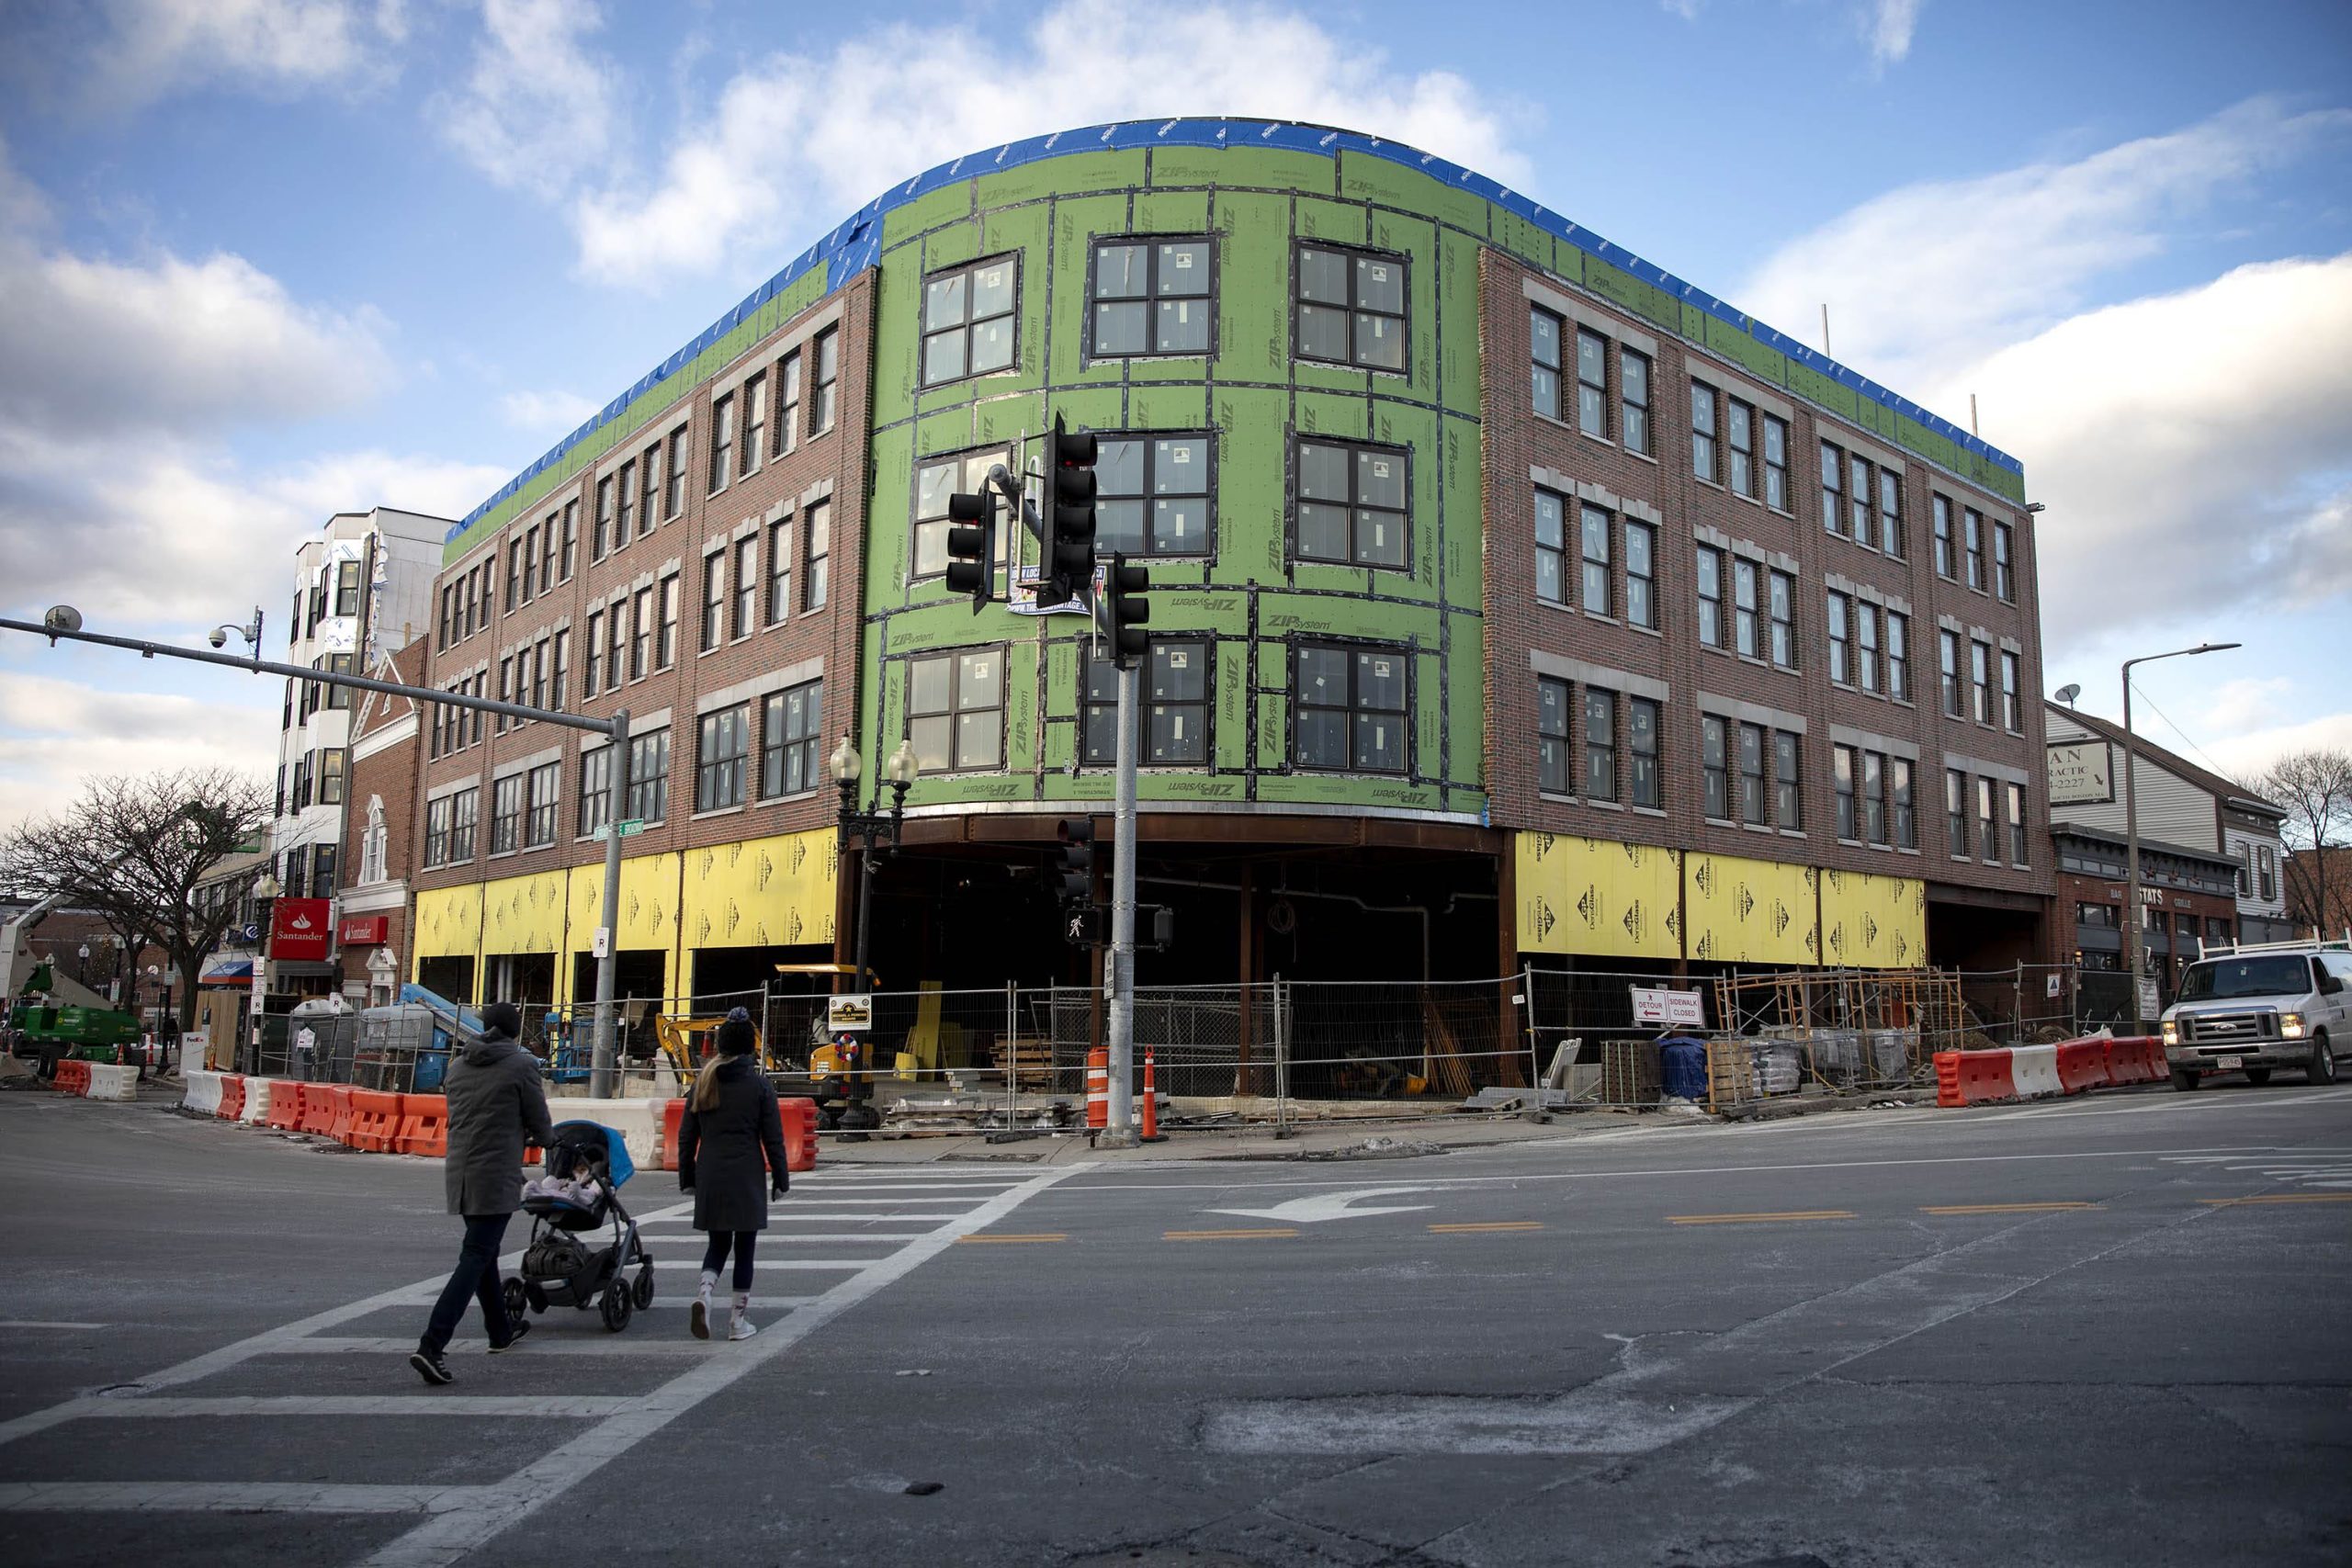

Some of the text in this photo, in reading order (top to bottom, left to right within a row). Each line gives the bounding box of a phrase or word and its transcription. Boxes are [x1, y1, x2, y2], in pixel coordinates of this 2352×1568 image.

[277, 931, 323, 941] Santander
[599, 938, 605, 948] R
[1638, 1001, 1663, 1010] DETOUR
[1669, 998, 1698, 1007] SIDEWALK
[1674, 1009, 1696, 1017] CLOSED
